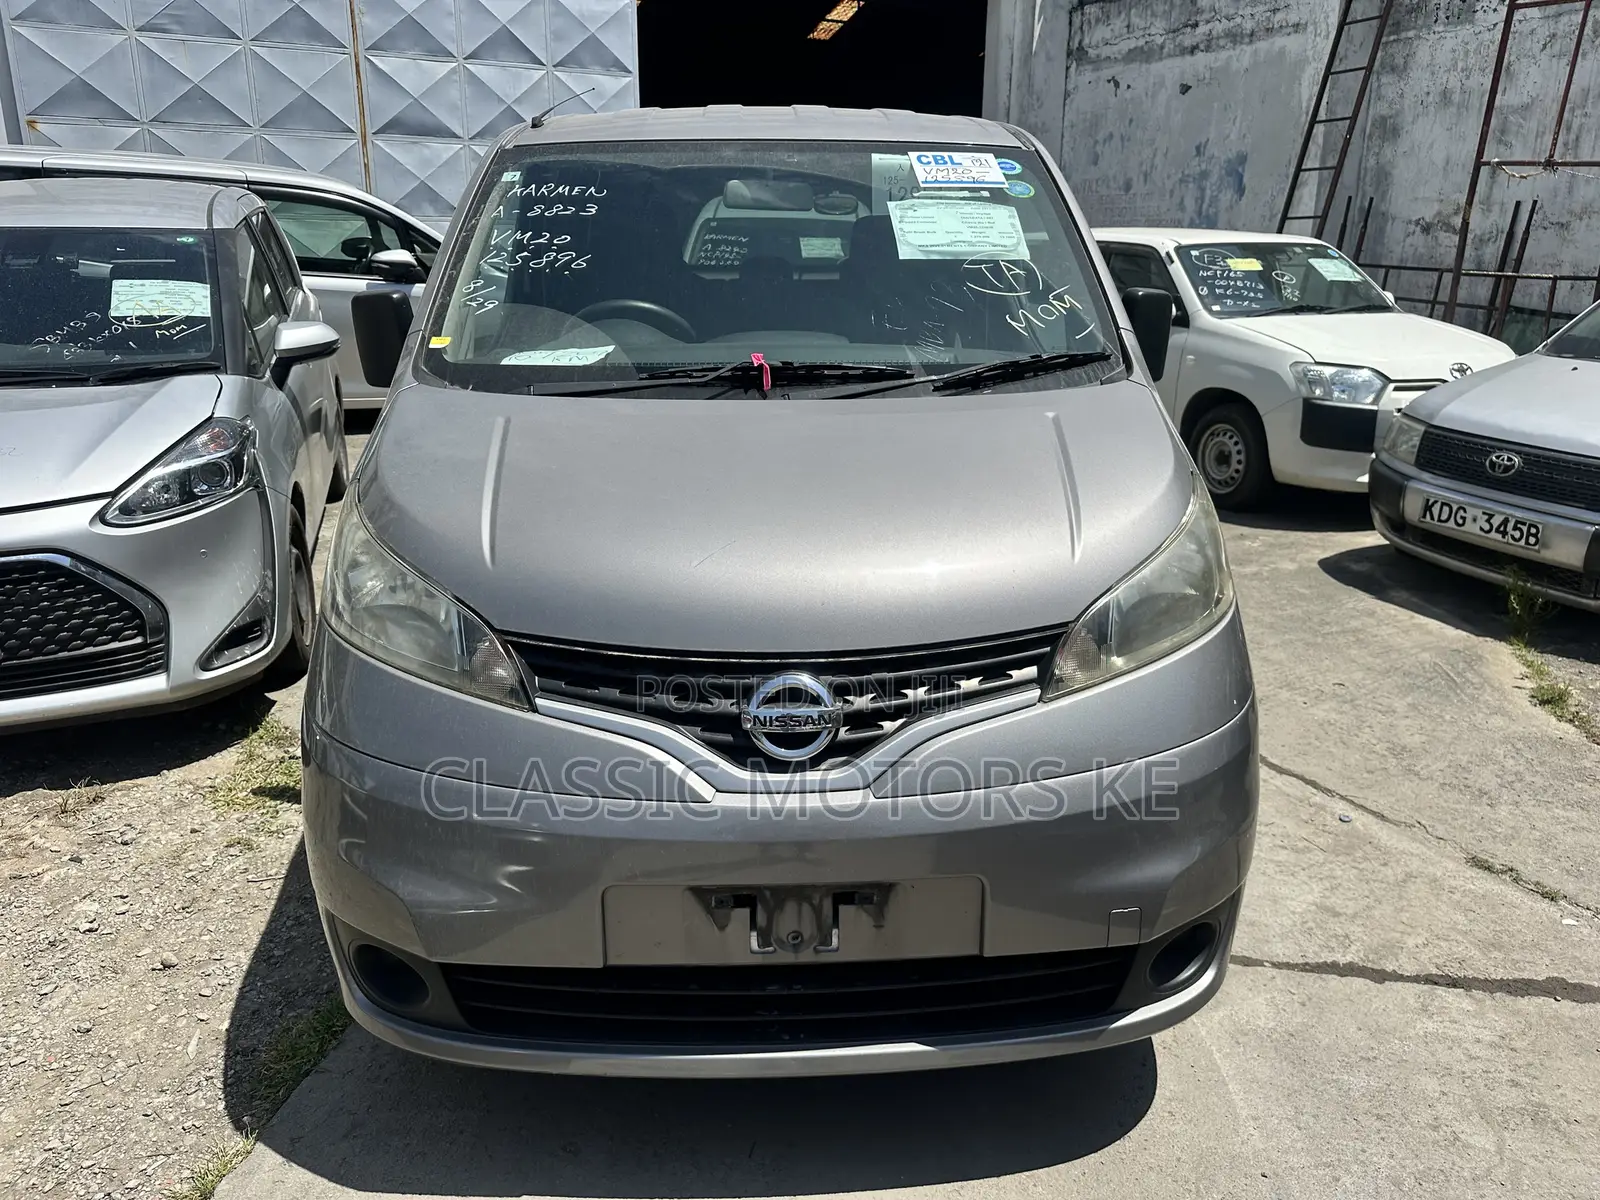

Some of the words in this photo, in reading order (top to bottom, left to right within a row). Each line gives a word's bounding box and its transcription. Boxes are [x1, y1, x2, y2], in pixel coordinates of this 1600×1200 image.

[916, 155, 963, 166] CBL
[507, 183, 607, 198] KARMEN
[1421, 498, 1467, 527] KDG
[1479, 511, 1541, 547] 345B
[751, 713, 833, 729] NISSAN
